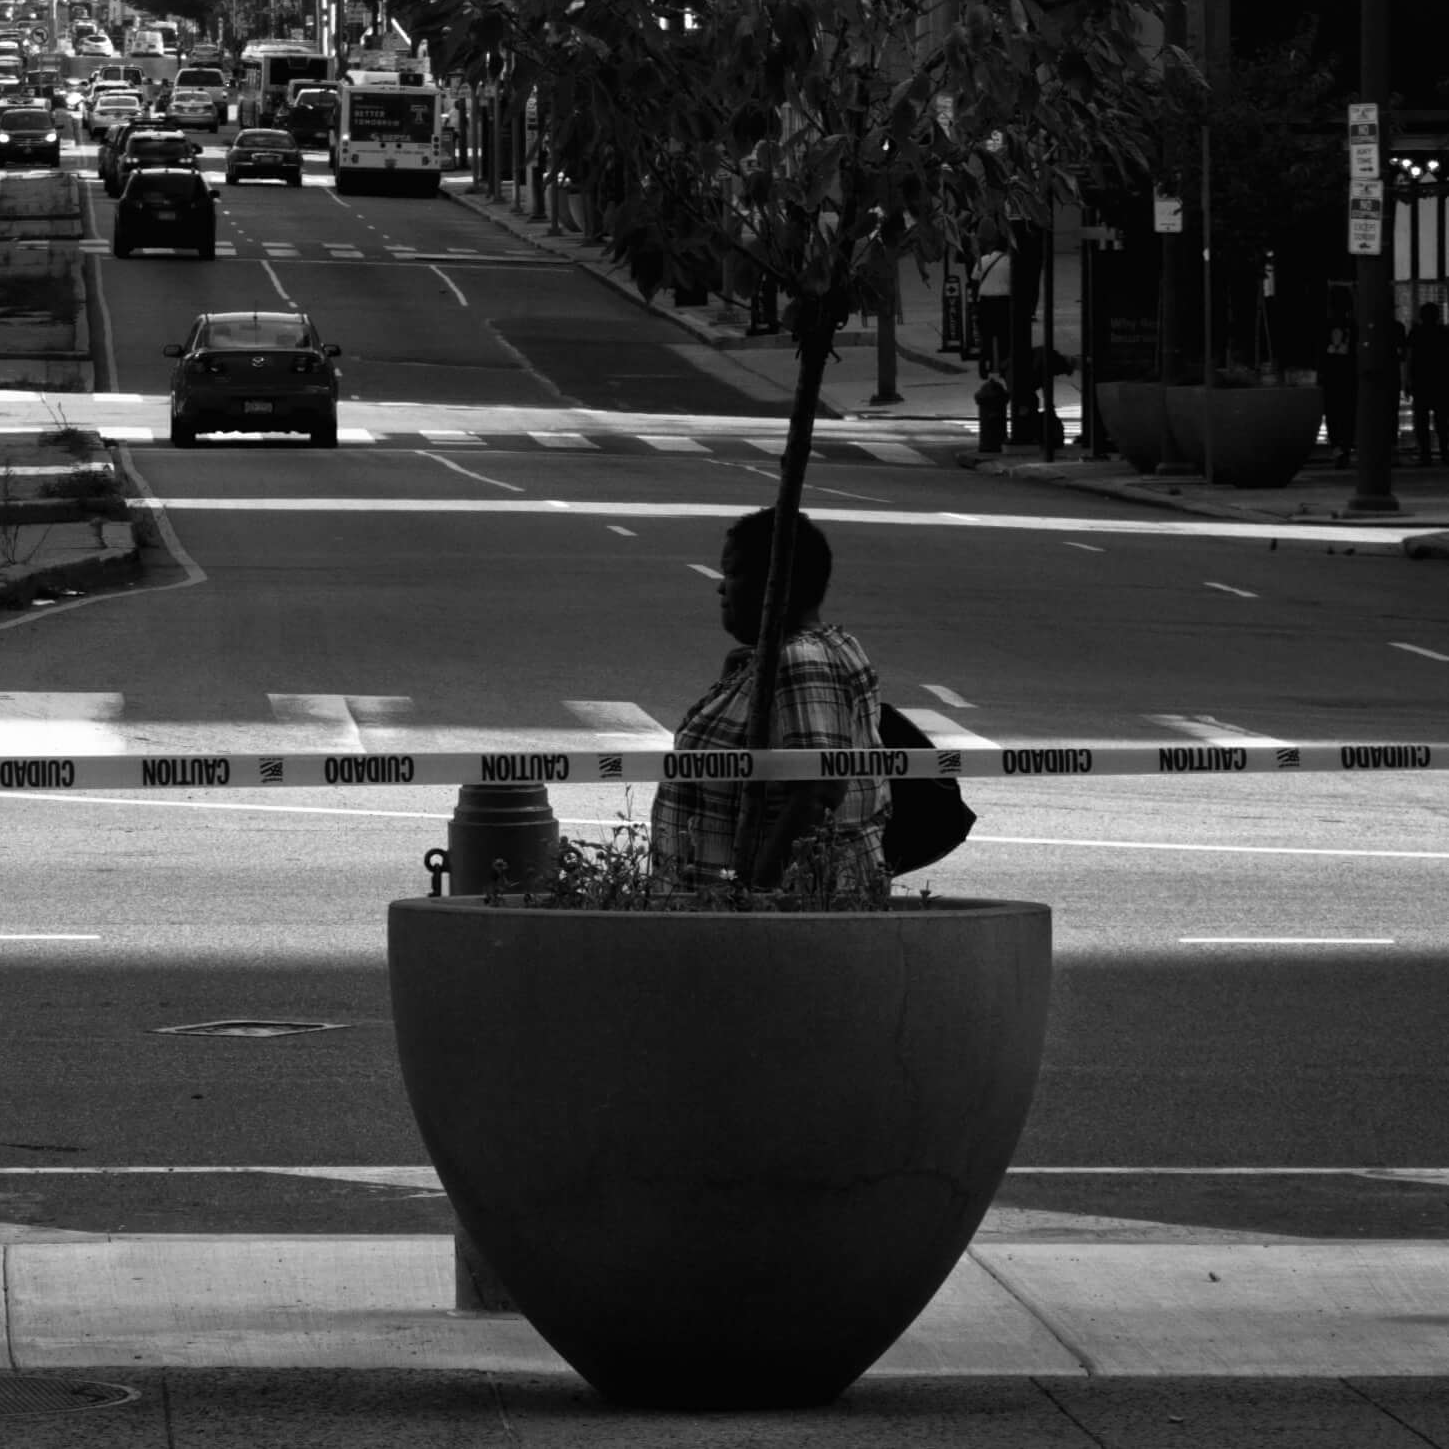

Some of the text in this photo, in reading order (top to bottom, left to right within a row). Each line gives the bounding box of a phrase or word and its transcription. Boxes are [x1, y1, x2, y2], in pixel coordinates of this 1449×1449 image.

[325, 756, 414, 783] CUIDADO
[482, 755, 569, 781] CAUTION
[664, 753, 753, 779] CUIDADO
[820, 751, 909, 777] CAUTION
[1003, 749, 1092, 774] CUIDADO
[1159, 748, 1247, 772] CAUTION
[1341, 745, 1431, 769] CUIDADO
[143, 759, 230, 786] CAUTION
